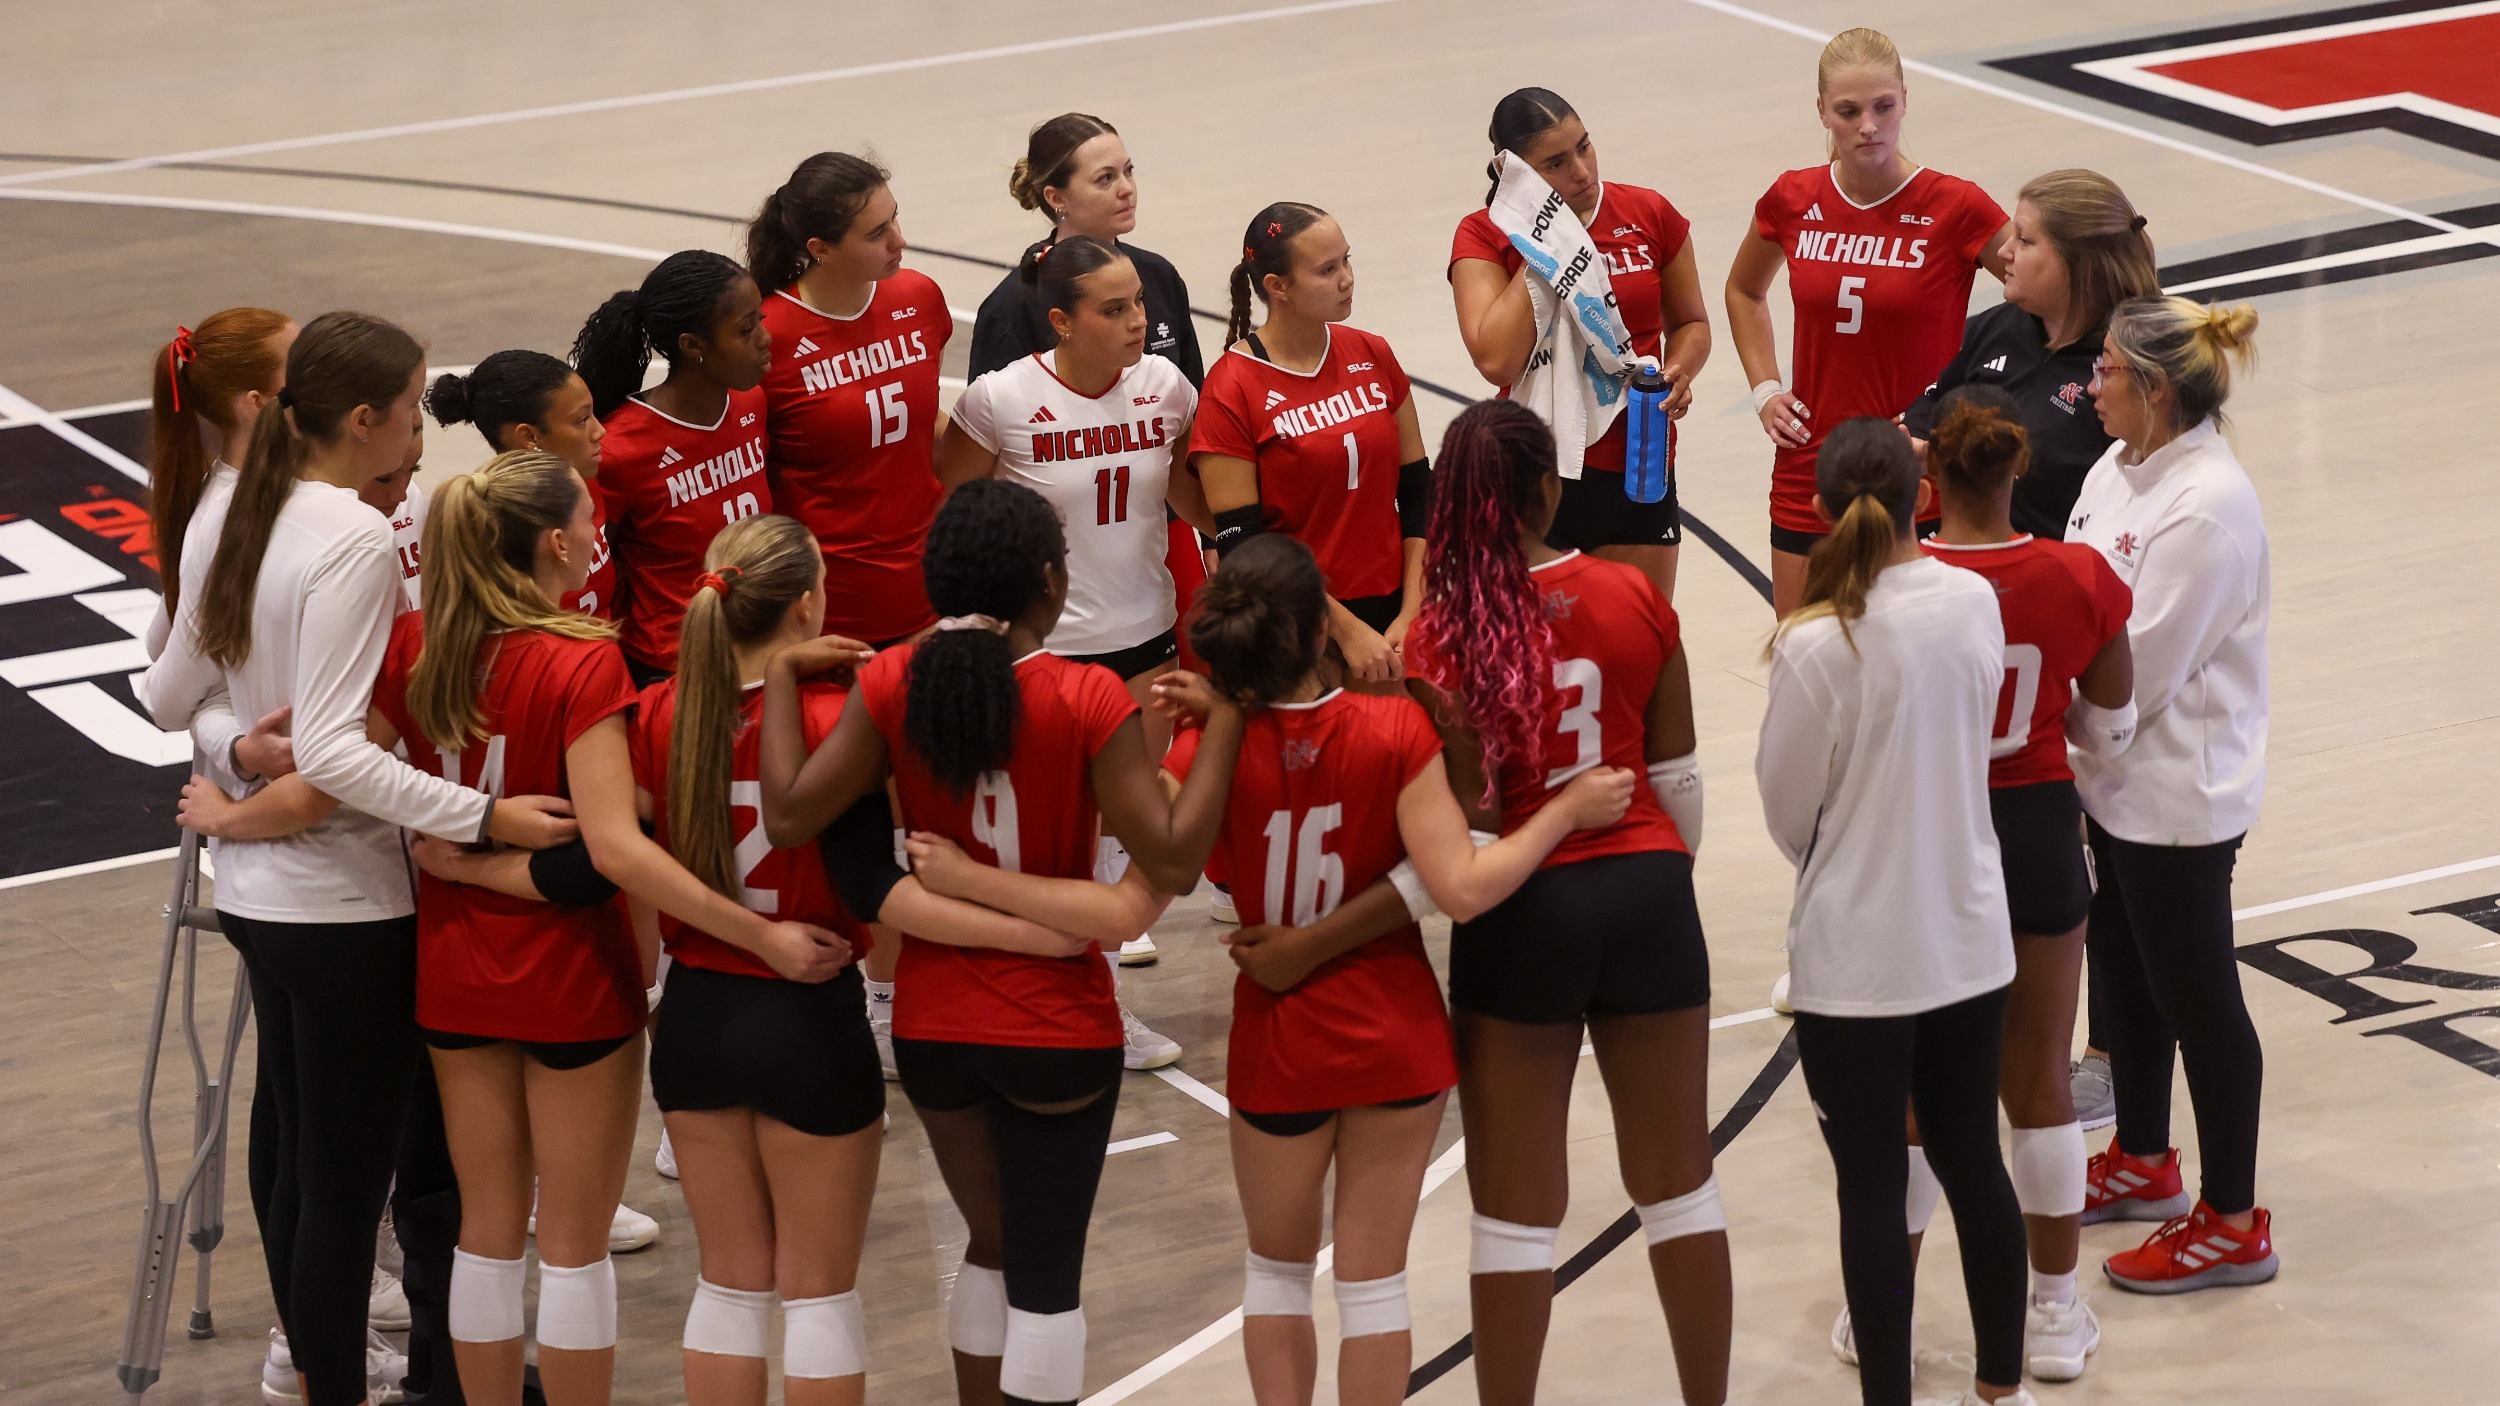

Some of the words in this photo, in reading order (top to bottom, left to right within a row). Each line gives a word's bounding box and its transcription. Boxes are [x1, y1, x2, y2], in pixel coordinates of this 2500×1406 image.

[1900, 214, 1934, 225] SLC
[1795, 230, 1928, 269] NICHOLLS
[891, 306, 917, 321] SLC
[1836, 277, 1866, 334] 5
[801, 330, 927, 396] NICHOLLS
[1347, 361, 1374, 373] SLC
[740, 412, 756, 427] SLC
[865, 381, 908, 448] 15
[1133, 395, 1162, 406] SLC
[1272, 382, 1387, 439] NICHOLLS
[1032, 417, 1166, 463] NICHOLLS
[1343, 432, 1359, 490] 1
[665, 436, 765, 508] NICHOLLS
[1094, 465, 1130, 525] 11
[392, 516, 413, 531] SLC
[1544, 657, 1602, 790] 3
[1263, 801, 1344, 928] 16
